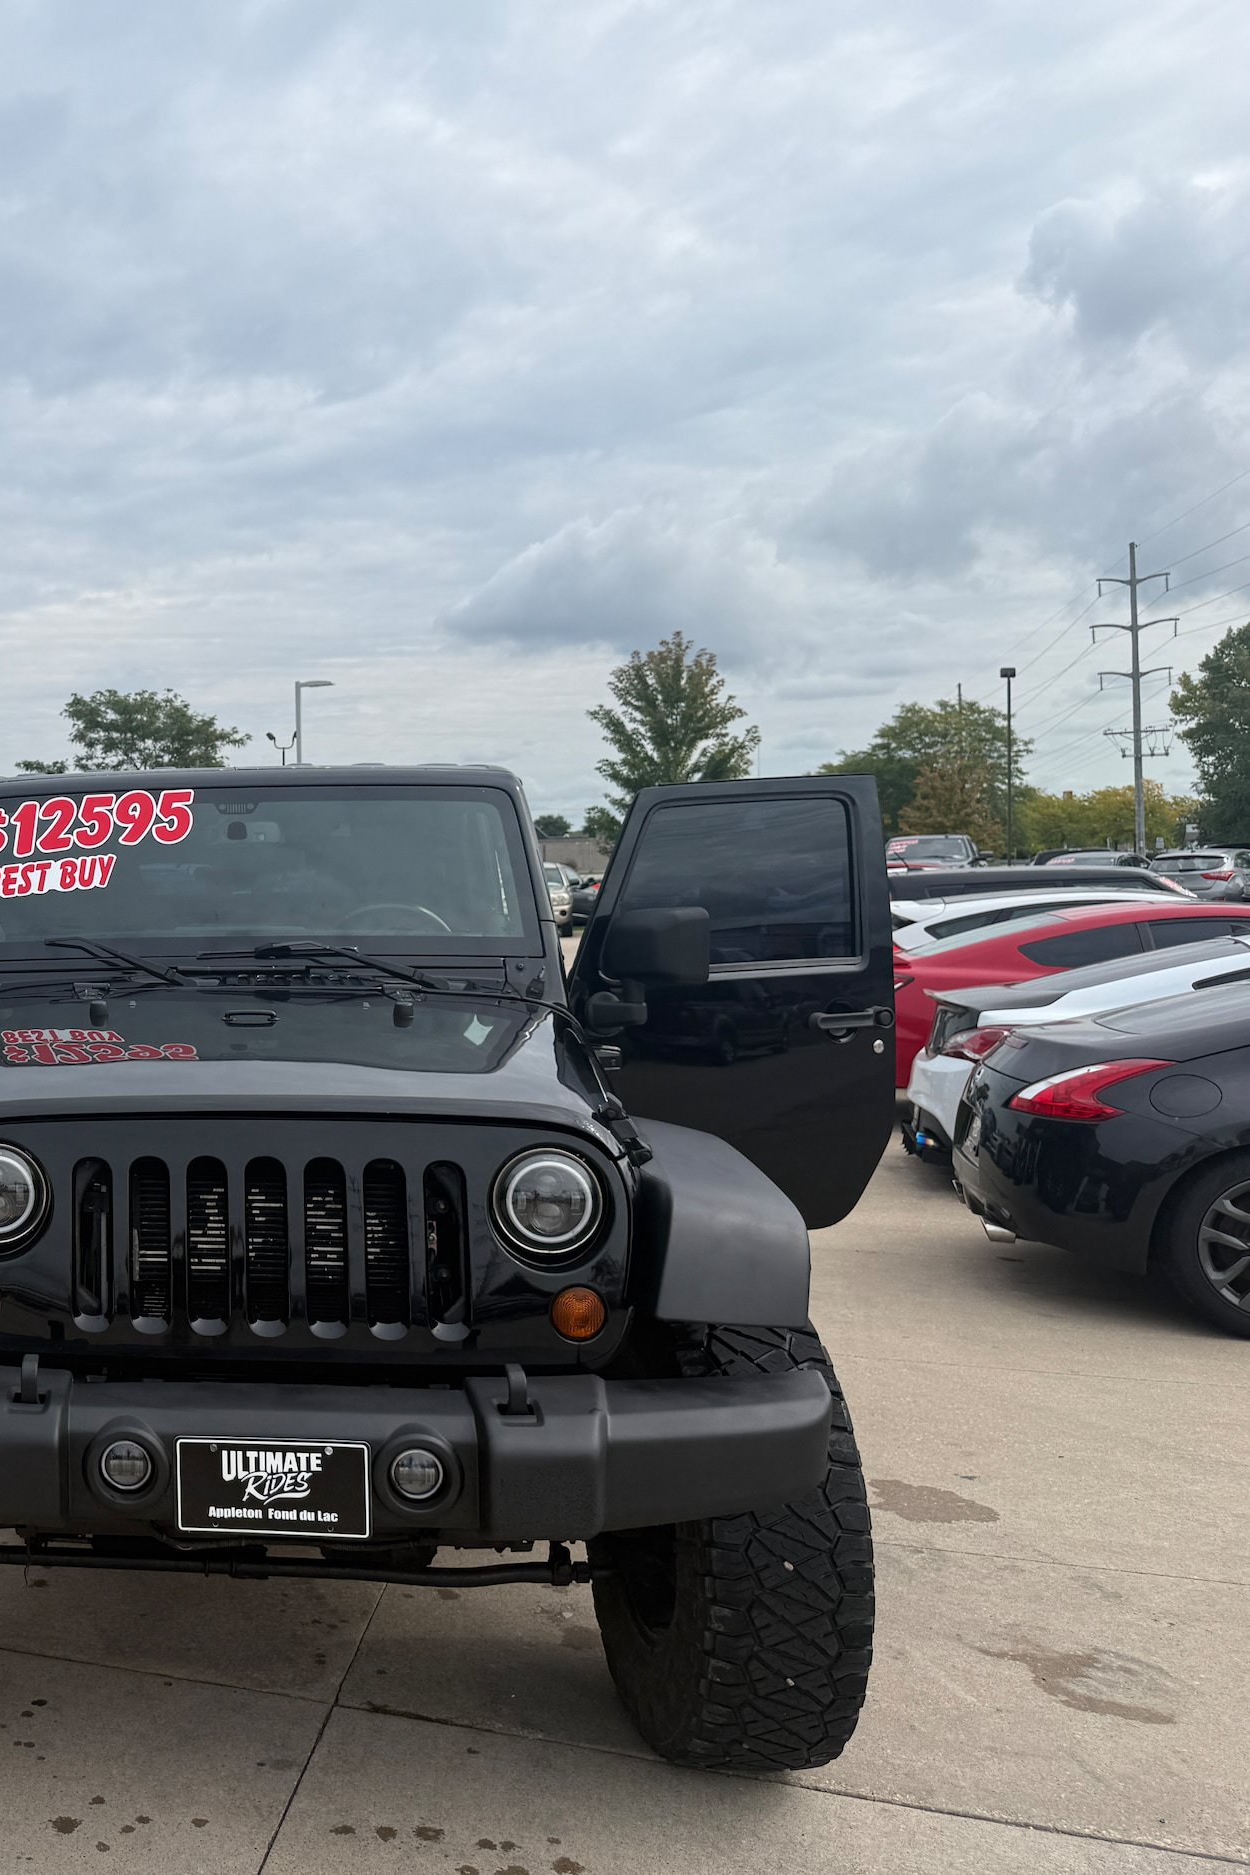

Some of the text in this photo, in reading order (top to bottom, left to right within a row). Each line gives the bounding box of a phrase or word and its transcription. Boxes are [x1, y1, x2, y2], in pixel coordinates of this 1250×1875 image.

[59, 855, 116, 891] BUY
[221, 1450, 323, 1481] ULTIMATE
[208, 1506, 339, 1522] Appleton Fond du Lac
